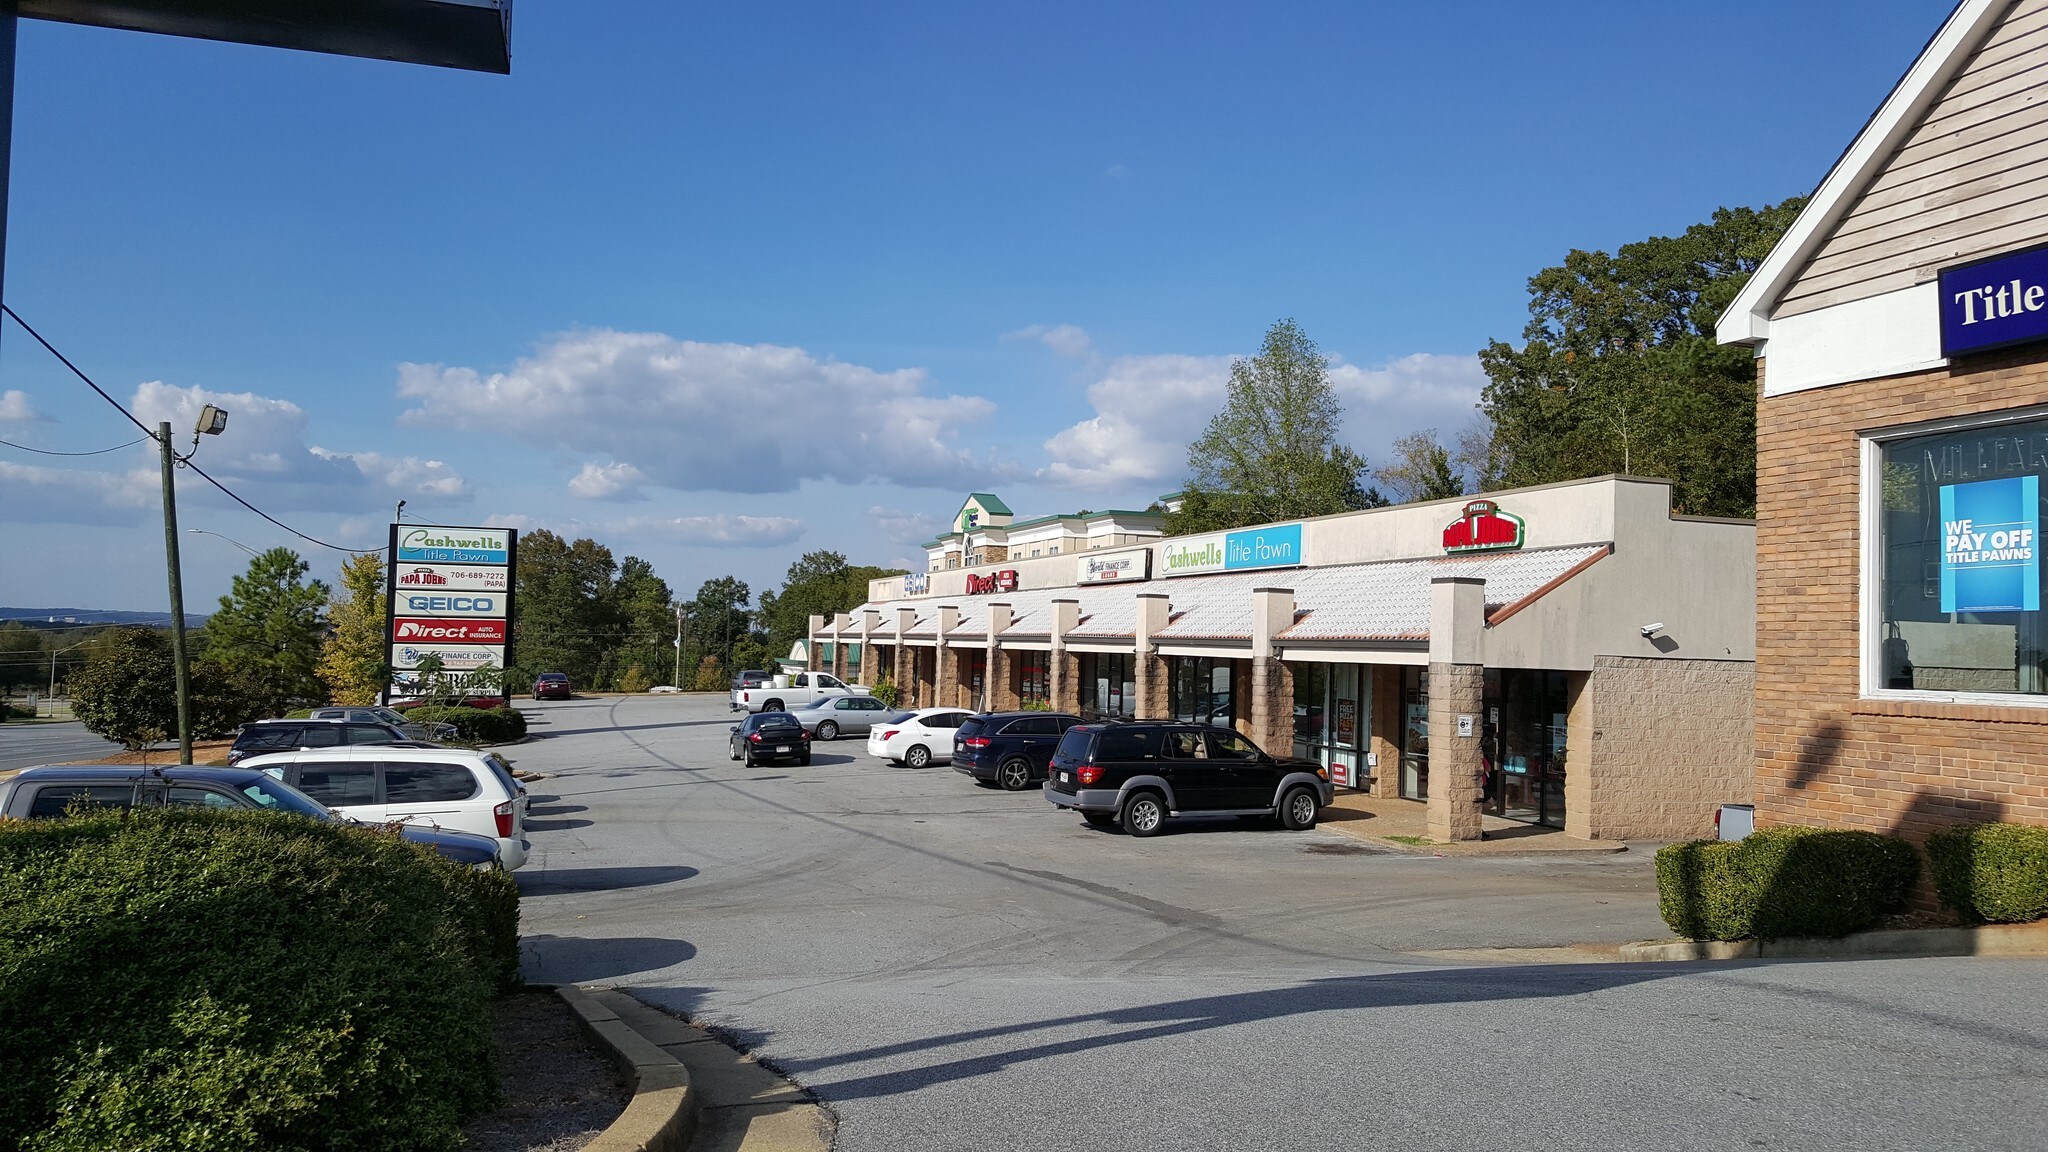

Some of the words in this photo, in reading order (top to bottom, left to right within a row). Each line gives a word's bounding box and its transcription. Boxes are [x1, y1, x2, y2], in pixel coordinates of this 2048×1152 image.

[1955, 279, 2045, 326] Title
[1469, 503, 1488, 512] PIZZA
[1945, 519, 1972, 535] WE
[402, 529, 502, 553] Cashwells
[1946, 532, 1987, 552] PAY
[1990, 529, 2033, 549] OFF
[423, 549, 448, 560] Title
[453, 549, 489, 561] Pawn
[1161, 543, 1222, 572] Cashwells
[1228, 539, 1252, 562] Title
[1255, 536, 1291, 560] Pawn
[1946, 551, 1980, 564] TITLE
[1981, 547, 2032, 561] PAWNS
[1105, 561, 1120, 571] FINANCE
[400, 573, 420, 585] PAPA
[450, 571, 505, 580] 706-689-7272
[484, 580, 505, 588] (PAPA)
[965, 572, 997, 595] Direct
[408, 596, 493, 612] GEICO
[397, 622, 468, 638] Direct
[441, 652, 471, 660] FINANCE
[1339, 704, 1354, 713] FREE
[1339, 712, 1354, 720] PIZZA
